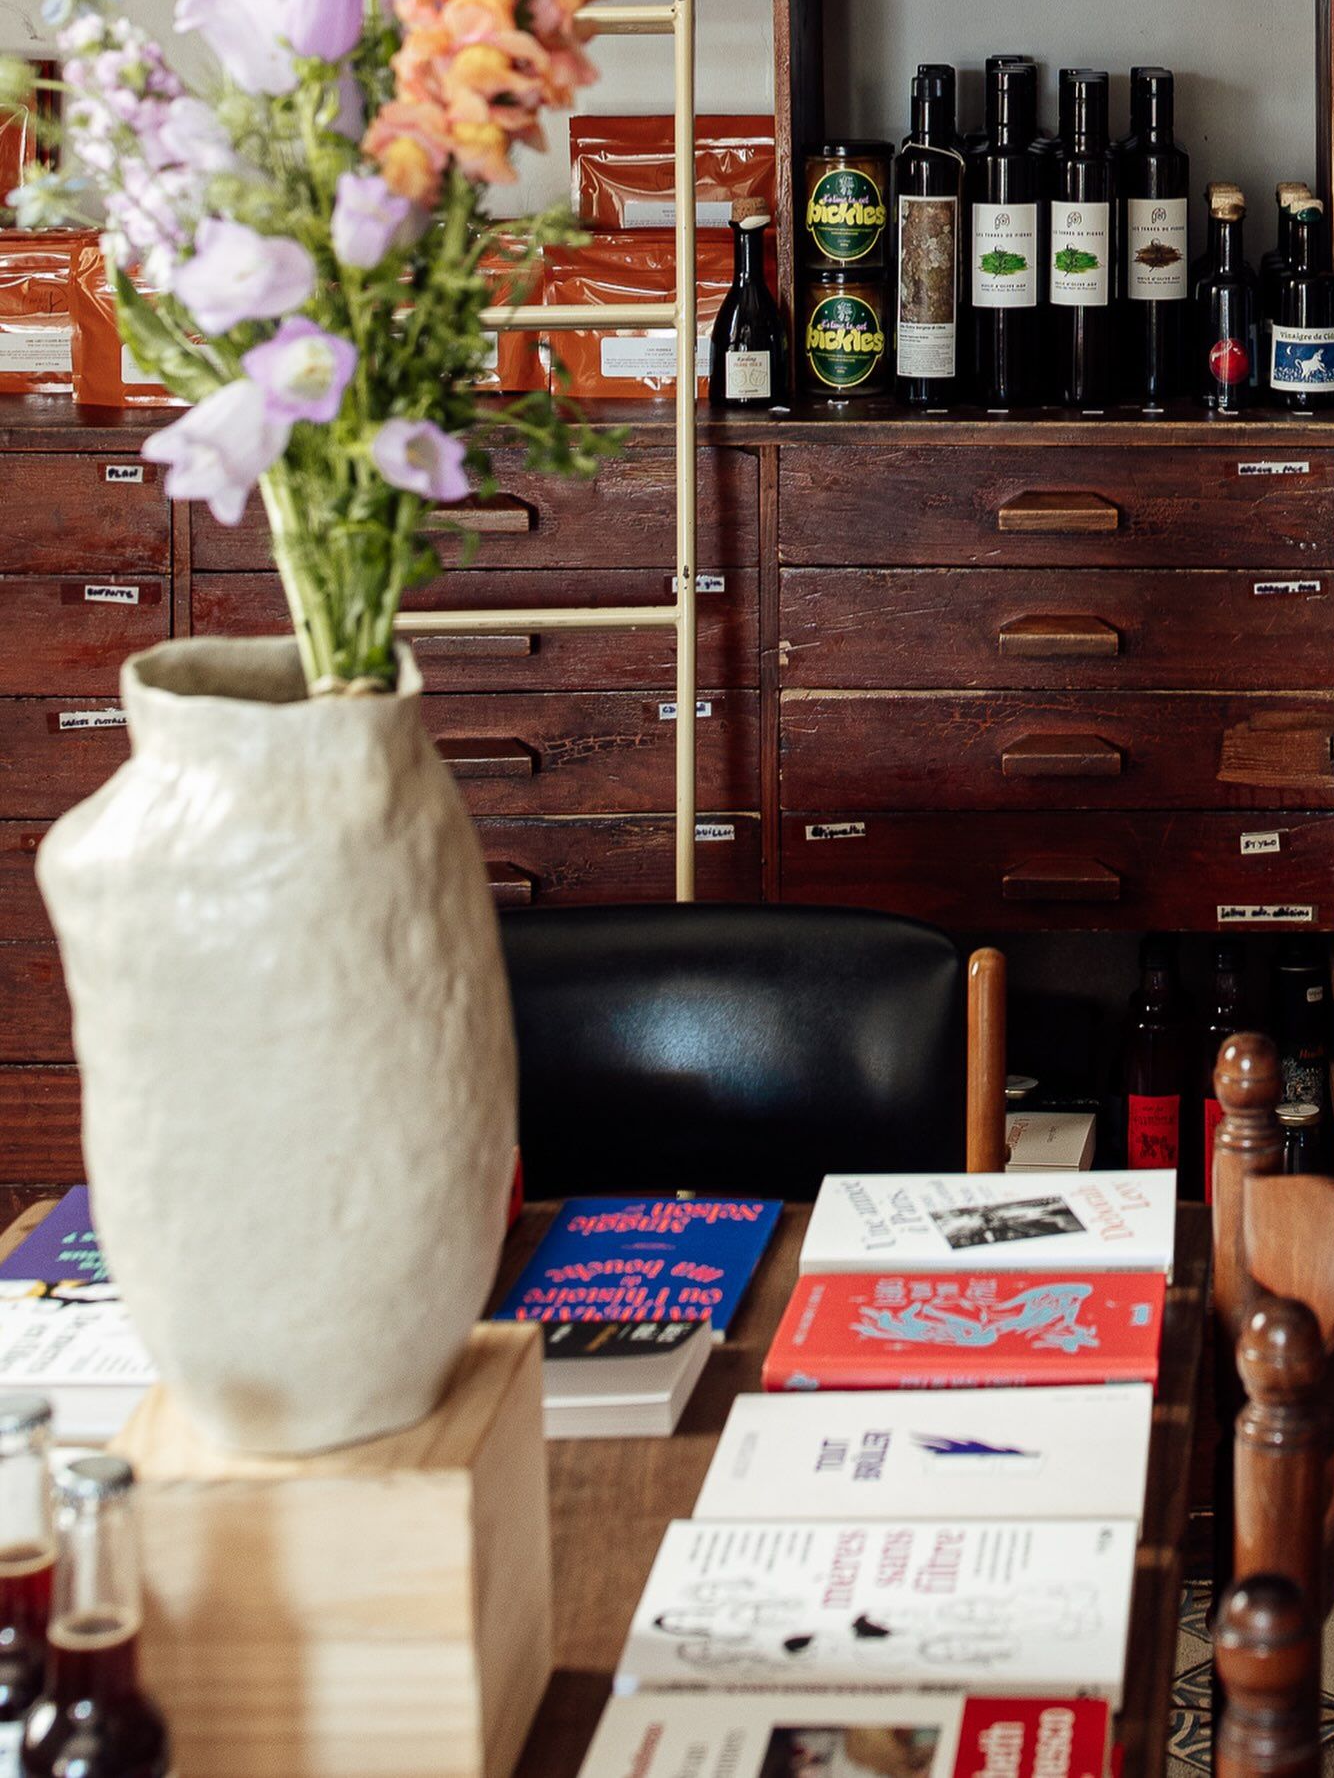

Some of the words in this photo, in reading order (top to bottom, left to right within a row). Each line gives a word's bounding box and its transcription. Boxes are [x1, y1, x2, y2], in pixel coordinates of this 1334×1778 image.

[807, 202, 887, 227] pickles
[806, 327, 885, 353] pickles
[107, 468, 138, 478] PLAN
[1243, 839, 1277, 849] STYLO
[544, 1258, 665, 1283] bouche
